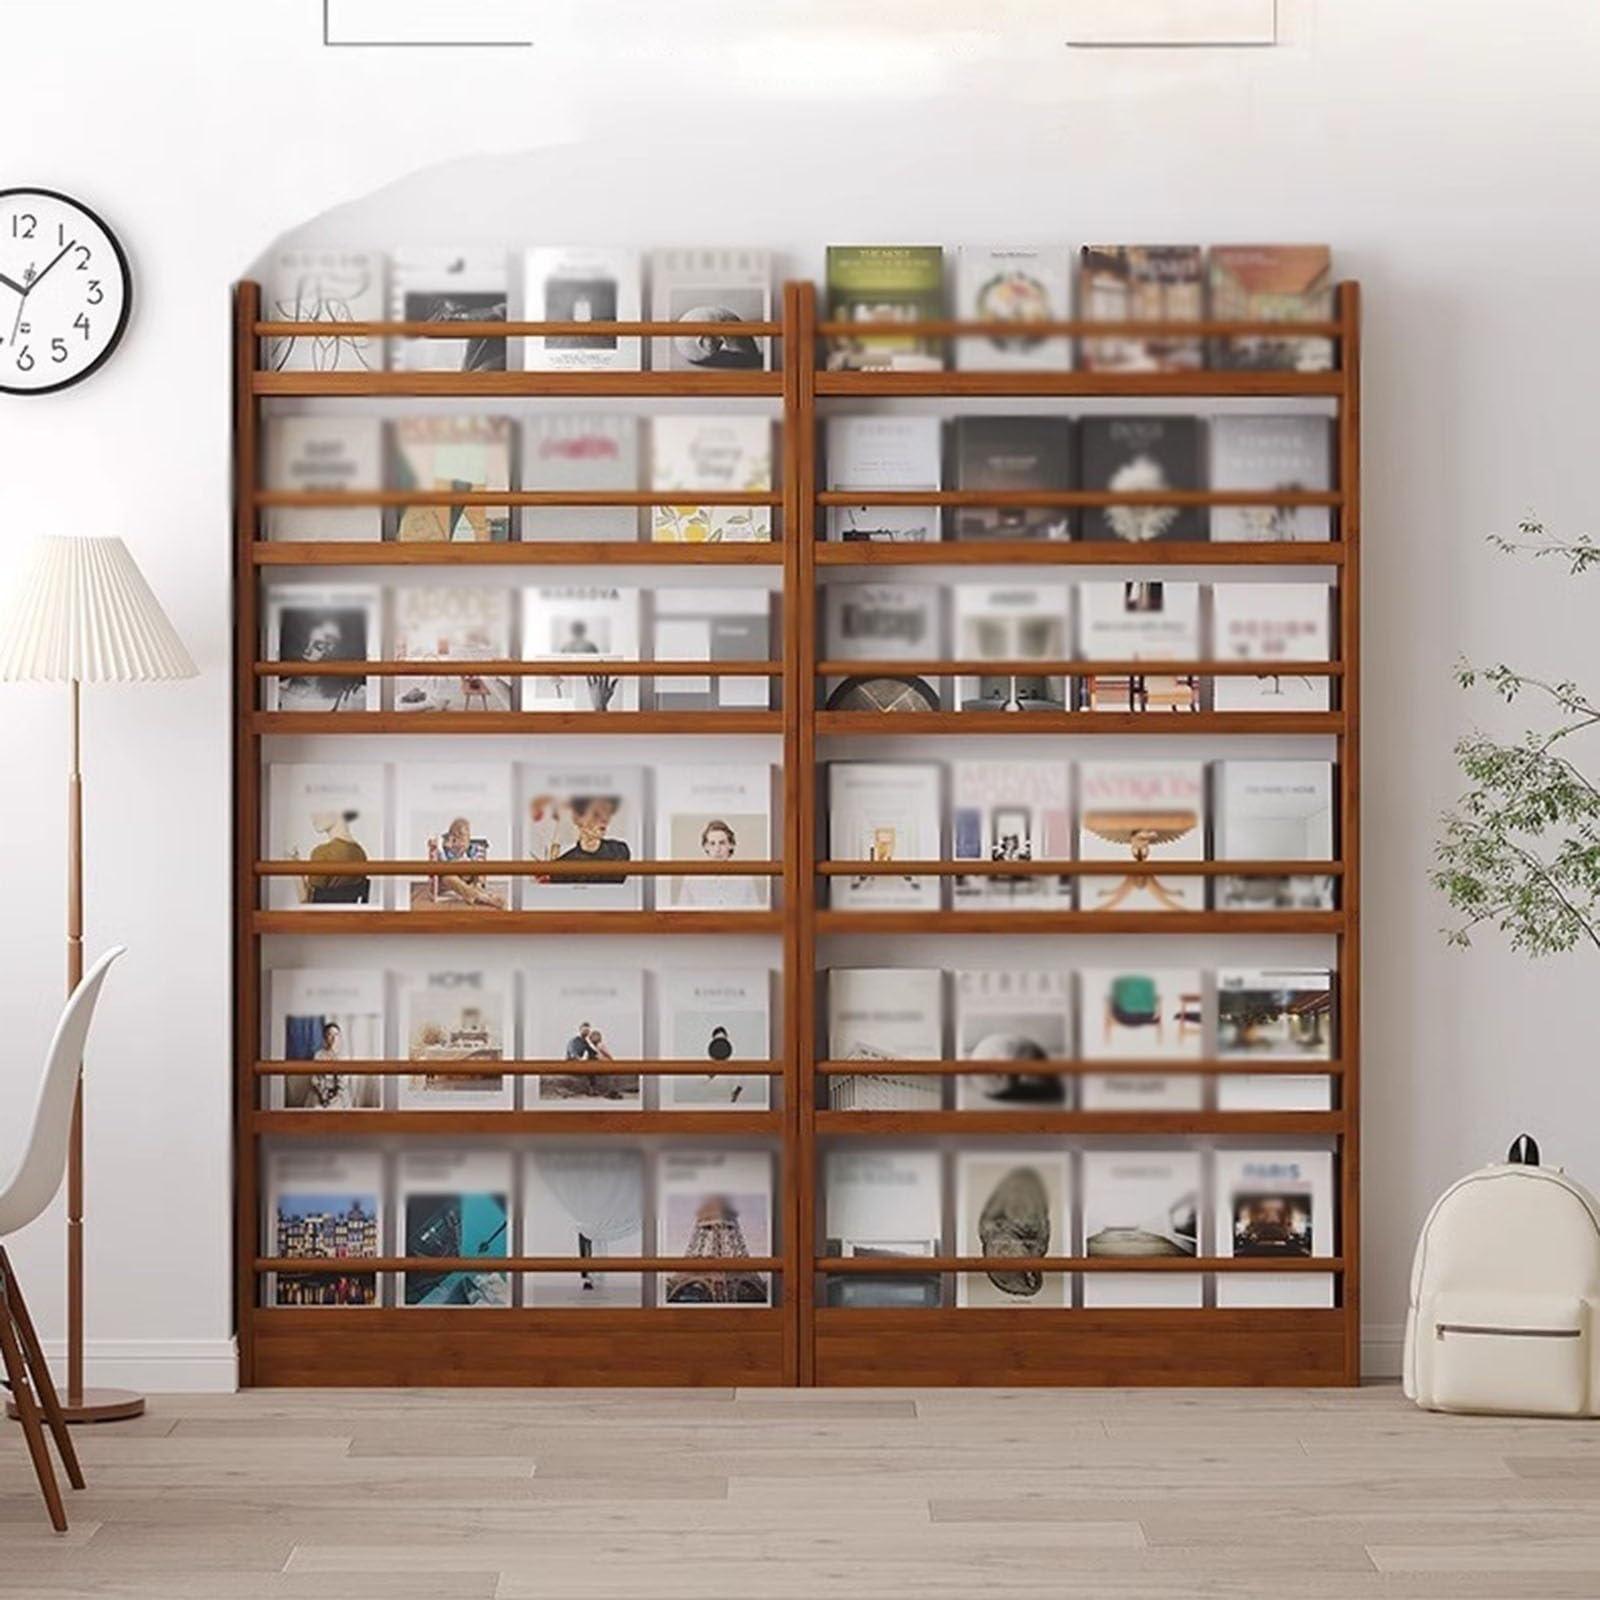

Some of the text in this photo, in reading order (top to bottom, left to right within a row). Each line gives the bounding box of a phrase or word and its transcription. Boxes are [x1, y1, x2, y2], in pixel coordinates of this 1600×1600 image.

[12, 213, 37, 239] 12
[58, 223, 64, 247] 1
[74, 245, 92, 271] 2
[86, 280, 104, 305] 3
[72, 312, 91, 341] 4
[15, 344, 35, 371] 6
[51, 337, 68, 363] 5
